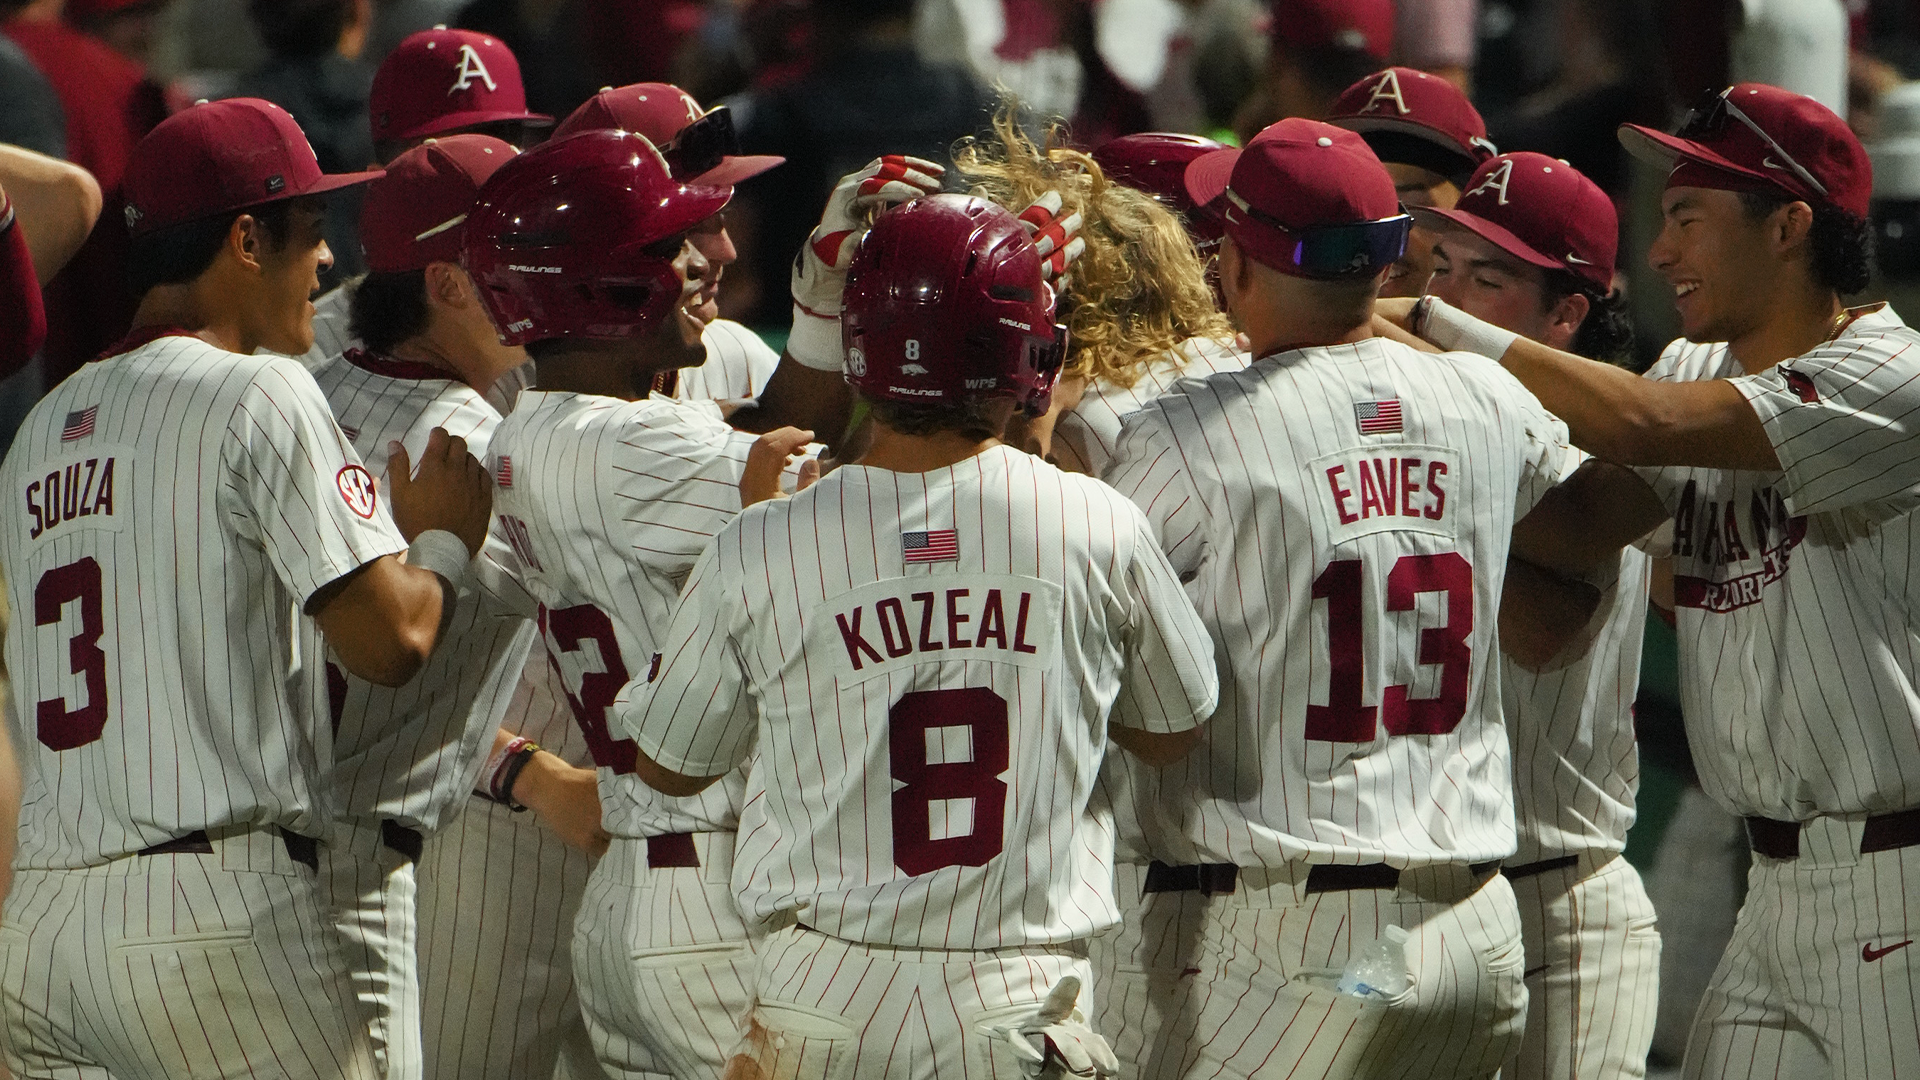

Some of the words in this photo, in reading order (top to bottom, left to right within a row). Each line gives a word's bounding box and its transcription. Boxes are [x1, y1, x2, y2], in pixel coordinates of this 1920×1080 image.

[448, 44, 497, 95] A
[1465, 159, 1513, 206] A
[508, 264, 563, 274] RAWLINGS
[507, 318, 534, 333] WPS
[904, 339, 921, 360] 8
[889, 386, 944, 397] RAWLINGS
[965, 377, 997, 390] WPS
[26, 457, 117, 541] SOUZA
[338, 467, 374, 516] SEC
[1326, 457, 1448, 526] EAVES
[34, 556, 109, 752] 3
[835, 588, 1037, 672] KOZEAL
[1304, 551, 1474, 743] 13
[889, 686, 1011, 878] 8
